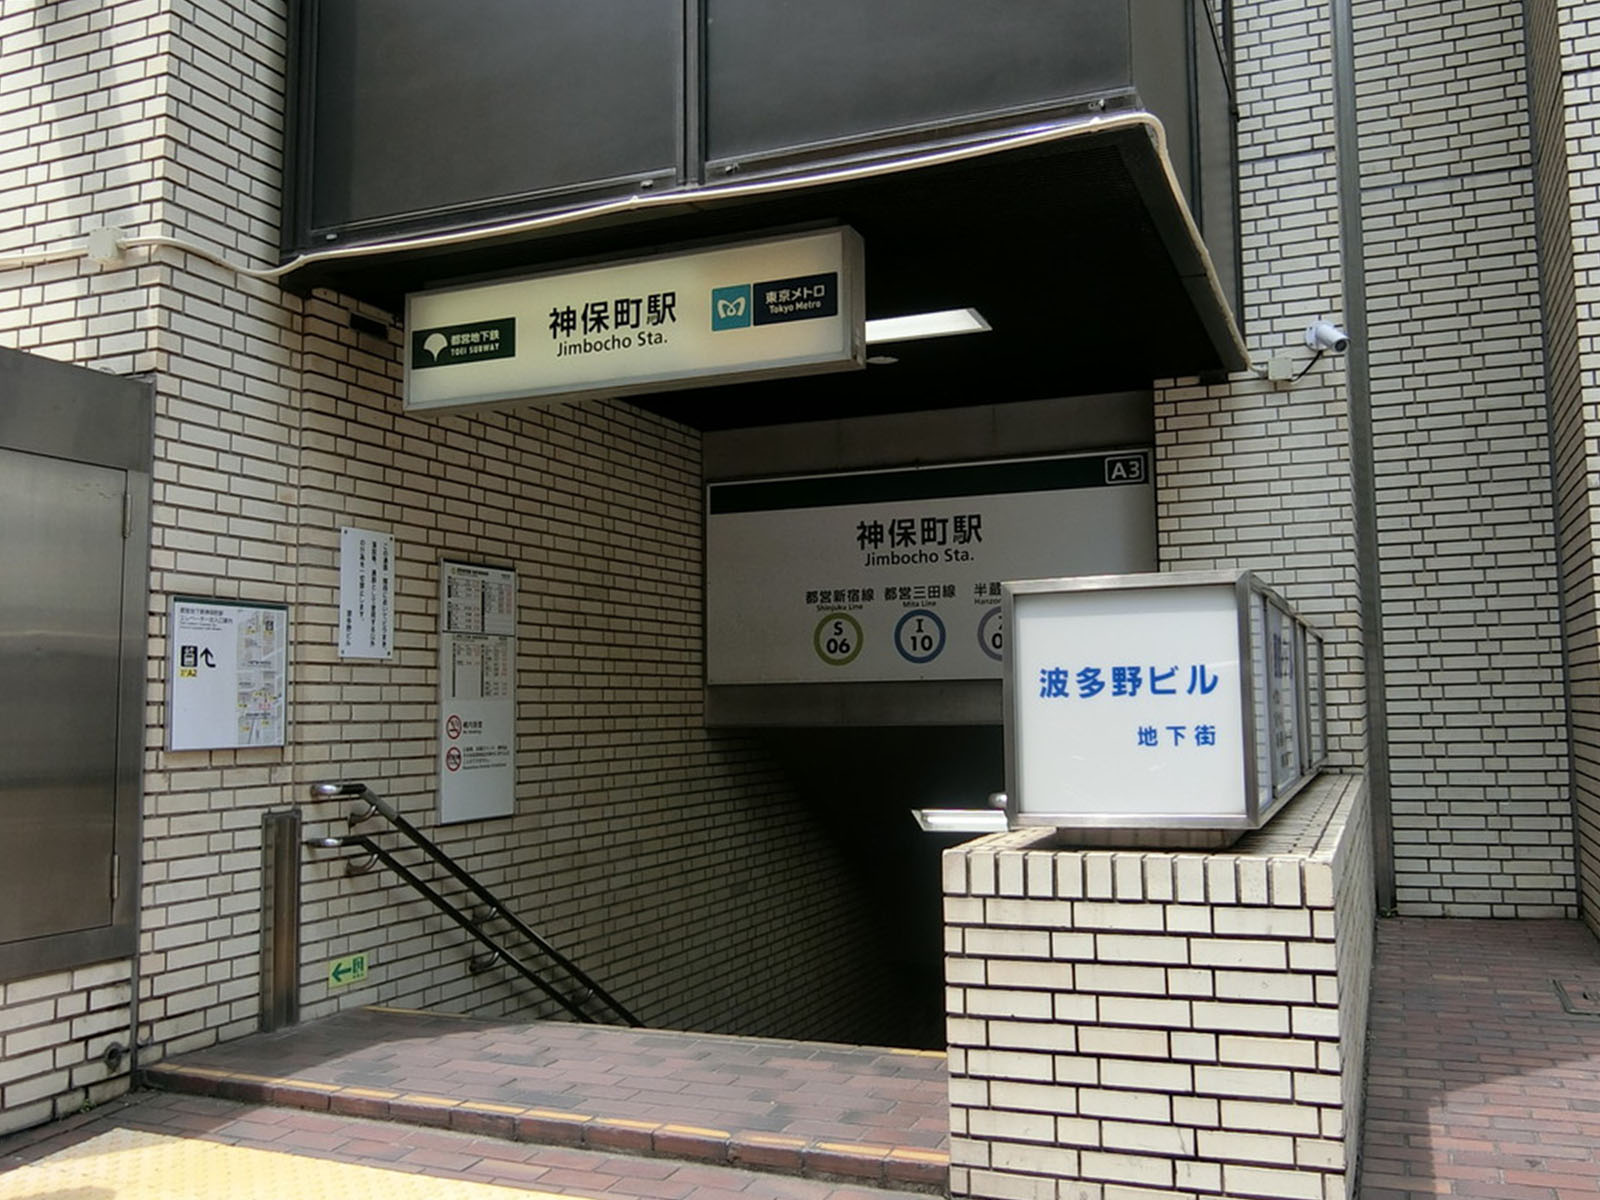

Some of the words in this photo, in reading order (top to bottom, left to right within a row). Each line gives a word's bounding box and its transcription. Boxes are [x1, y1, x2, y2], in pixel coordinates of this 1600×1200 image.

[765, 284, 826, 304] 東京メトロ
[769, 302, 793, 315] Tokyo
[794, 298, 822, 312] Metro
[548, 291, 678, 340] 神保町駅
[556, 334, 632, 358] Jimbocho
[637, 330, 669, 348] Sta.
[1111, 460, 1141, 480] A3
[856, 514, 982, 550] 神保町駅
[864, 550, 939, 567] Jimbocho
[945, 548, 975, 562] Sta.
[805, 588, 875, 604] 都営新宿線
[884, 584, 956, 601] 都営三田線
[849, 603, 863, 611] Line
[922, 600, 936, 608] Line
[833, 621, 843, 636] S
[915, 618, 924, 633] I
[826, 638, 850, 654] 06
[910, 635, 933, 651] 10
[1039, 663, 1219, 699] 波多野ビル
[1137, 725, 1216, 747] 地下街
